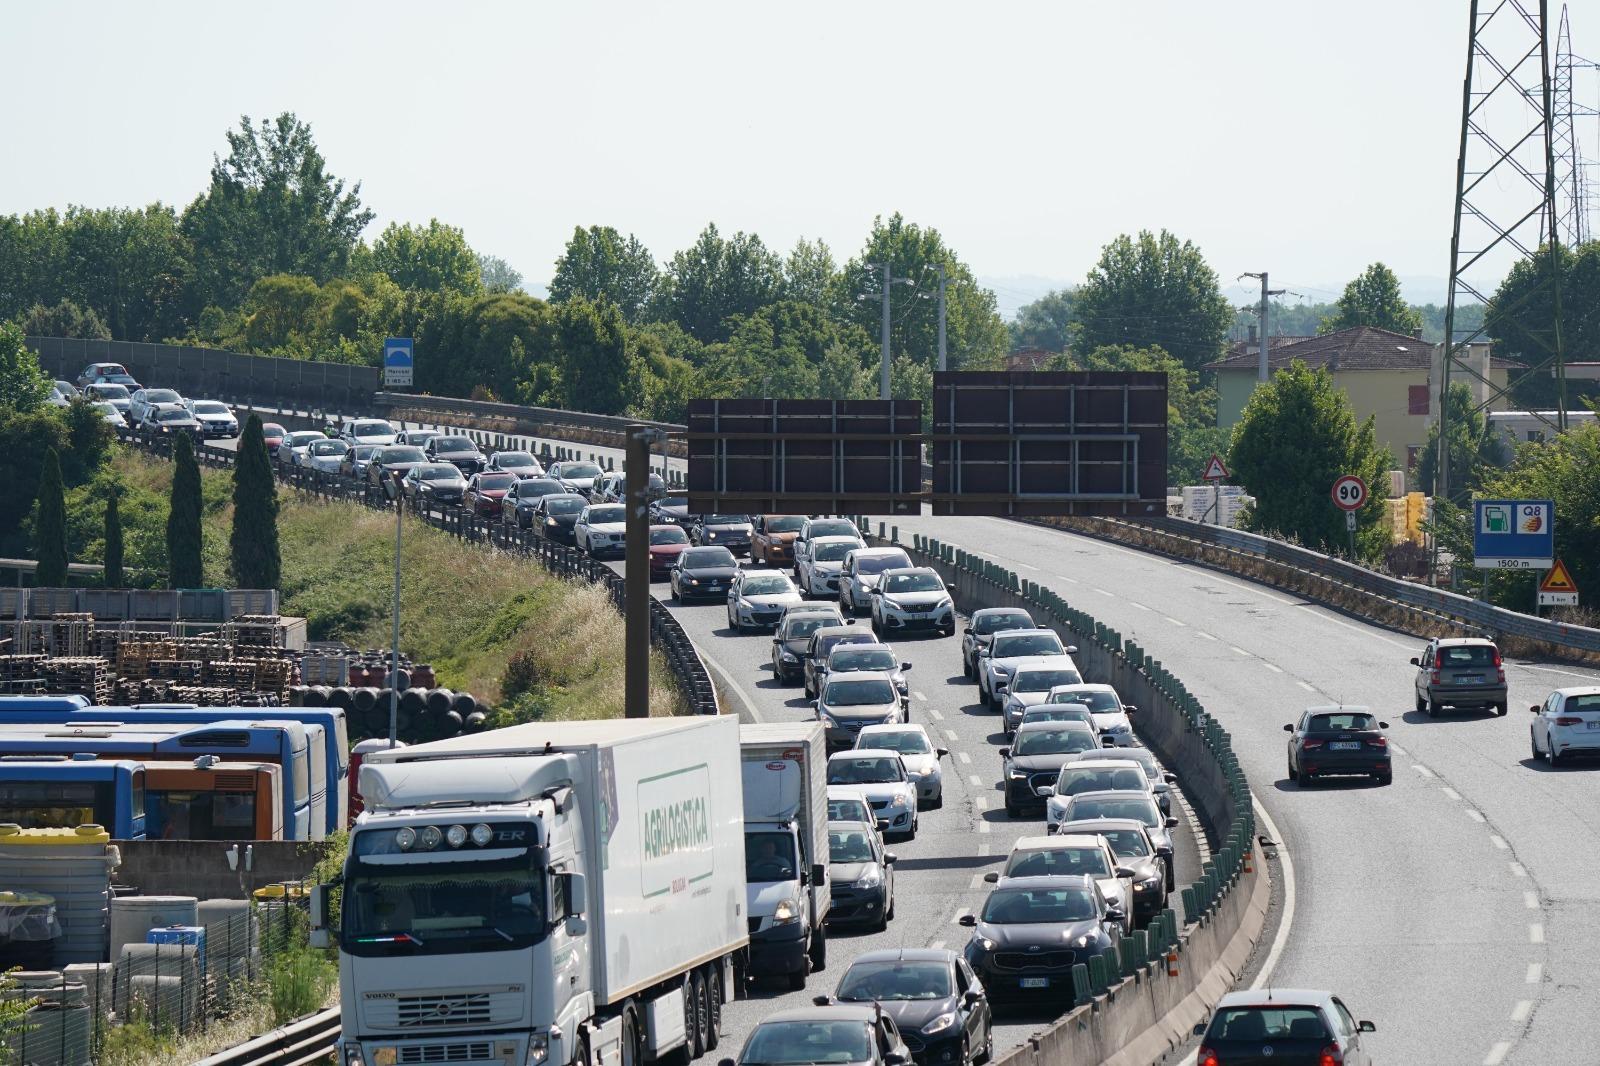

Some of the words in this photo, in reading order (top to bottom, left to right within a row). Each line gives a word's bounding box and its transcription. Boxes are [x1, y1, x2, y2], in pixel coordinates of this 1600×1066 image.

[1340, 485, 1360, 500] 90
[1523, 505, 1542, 516] Q8
[1497, 559, 1519, 568] 1500
